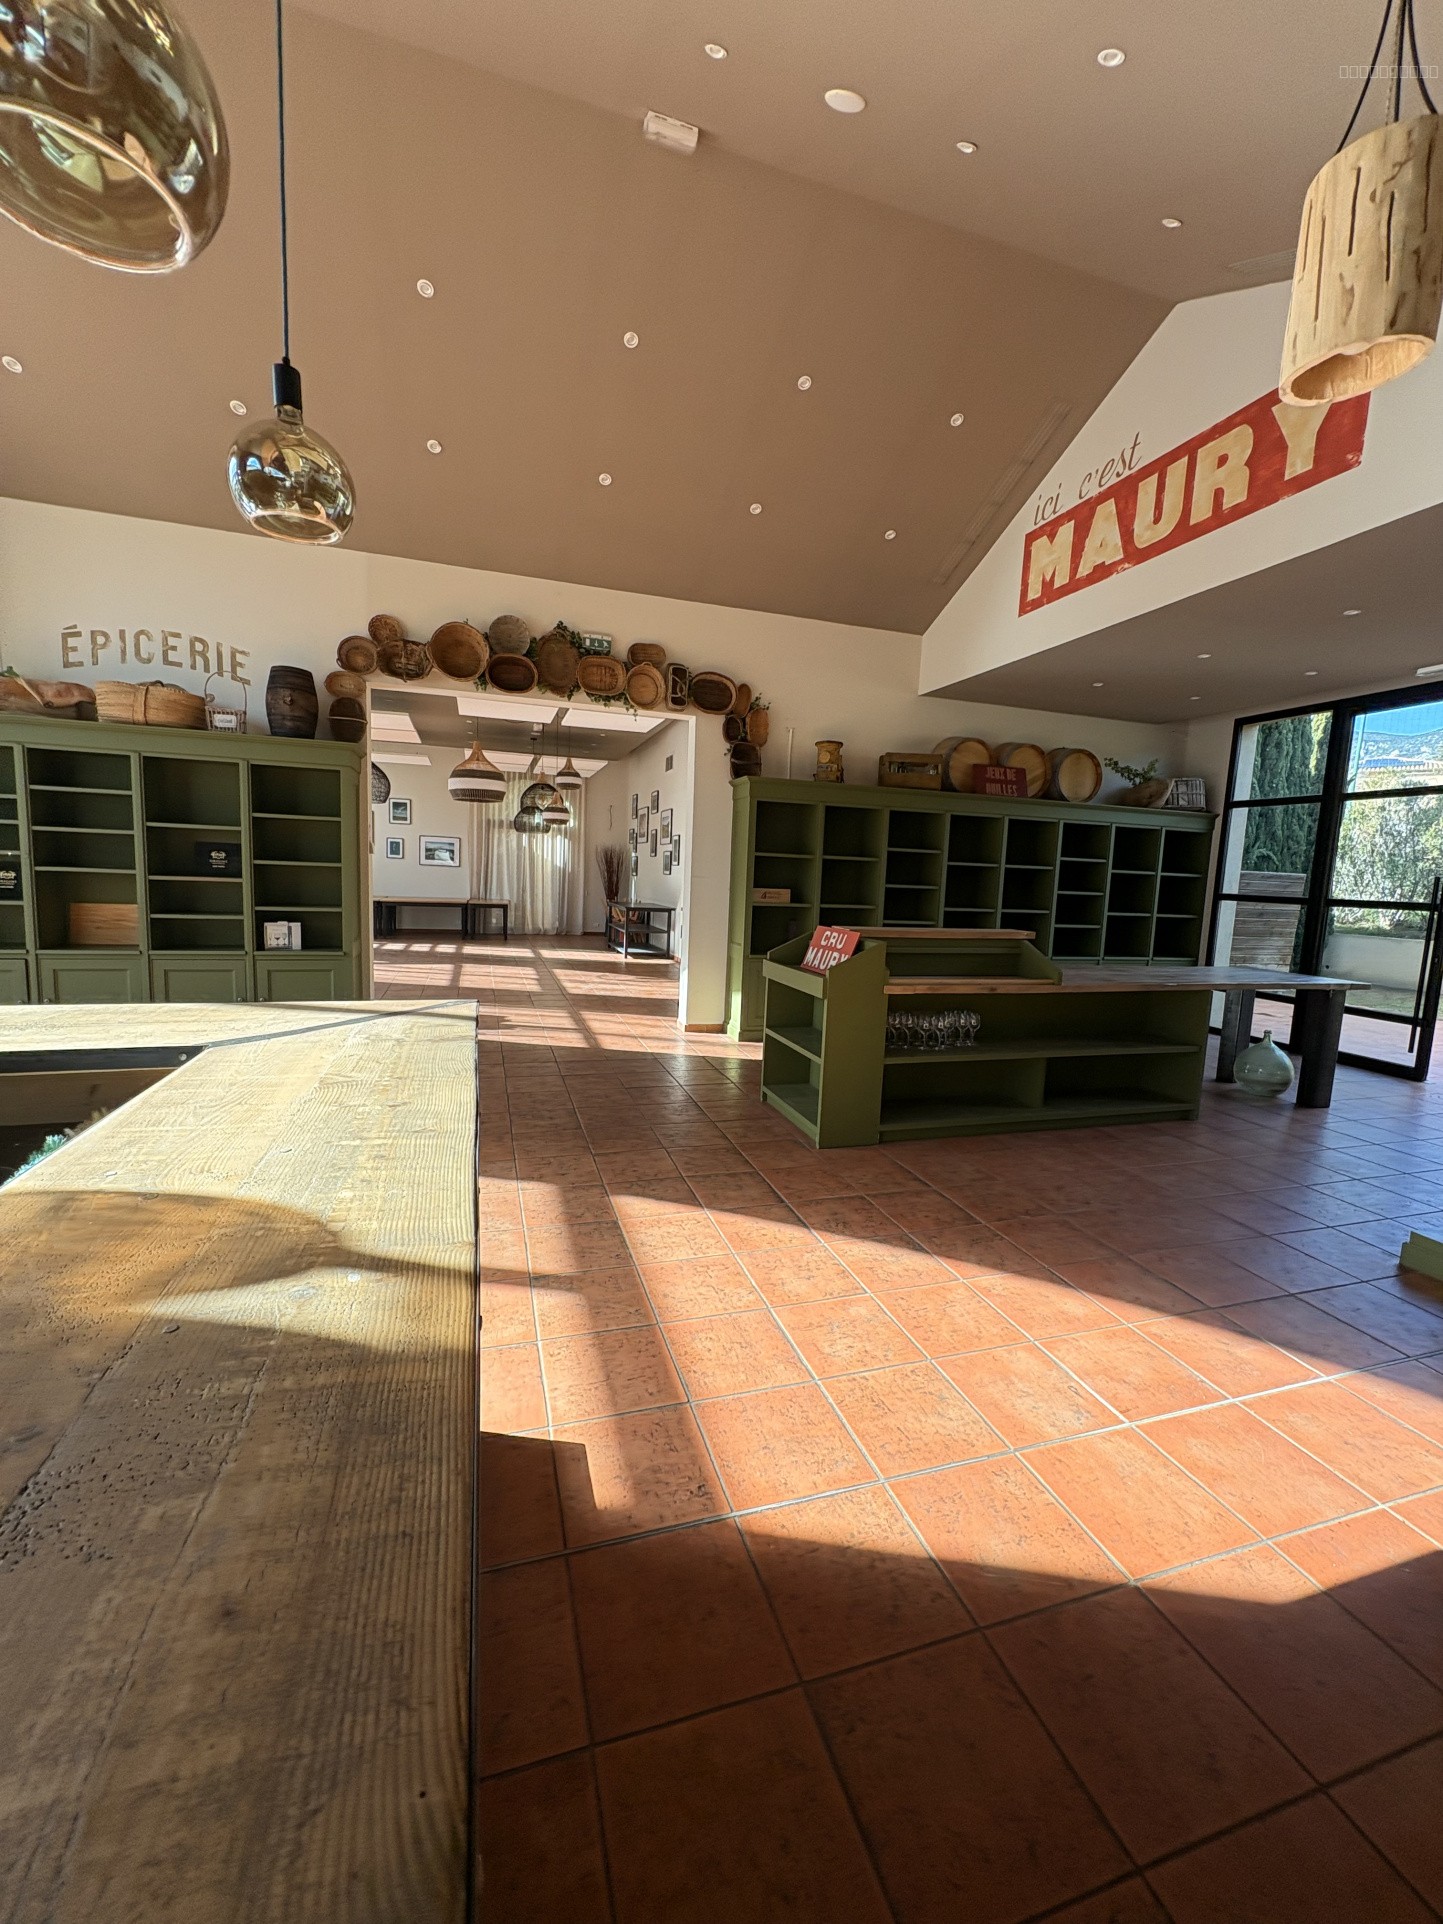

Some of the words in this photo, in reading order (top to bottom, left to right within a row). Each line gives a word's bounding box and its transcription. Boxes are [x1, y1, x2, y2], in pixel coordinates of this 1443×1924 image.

[1026, 402, 1334, 602] MAURY
[1034, 482, 1064, 526] ici
[1079, 431, 1142, 500] c'est
[61, 624, 251, 686] ÉPICERIE
[1006, 768, 1017, 781] DE
[820, 930, 848, 949] CRU
